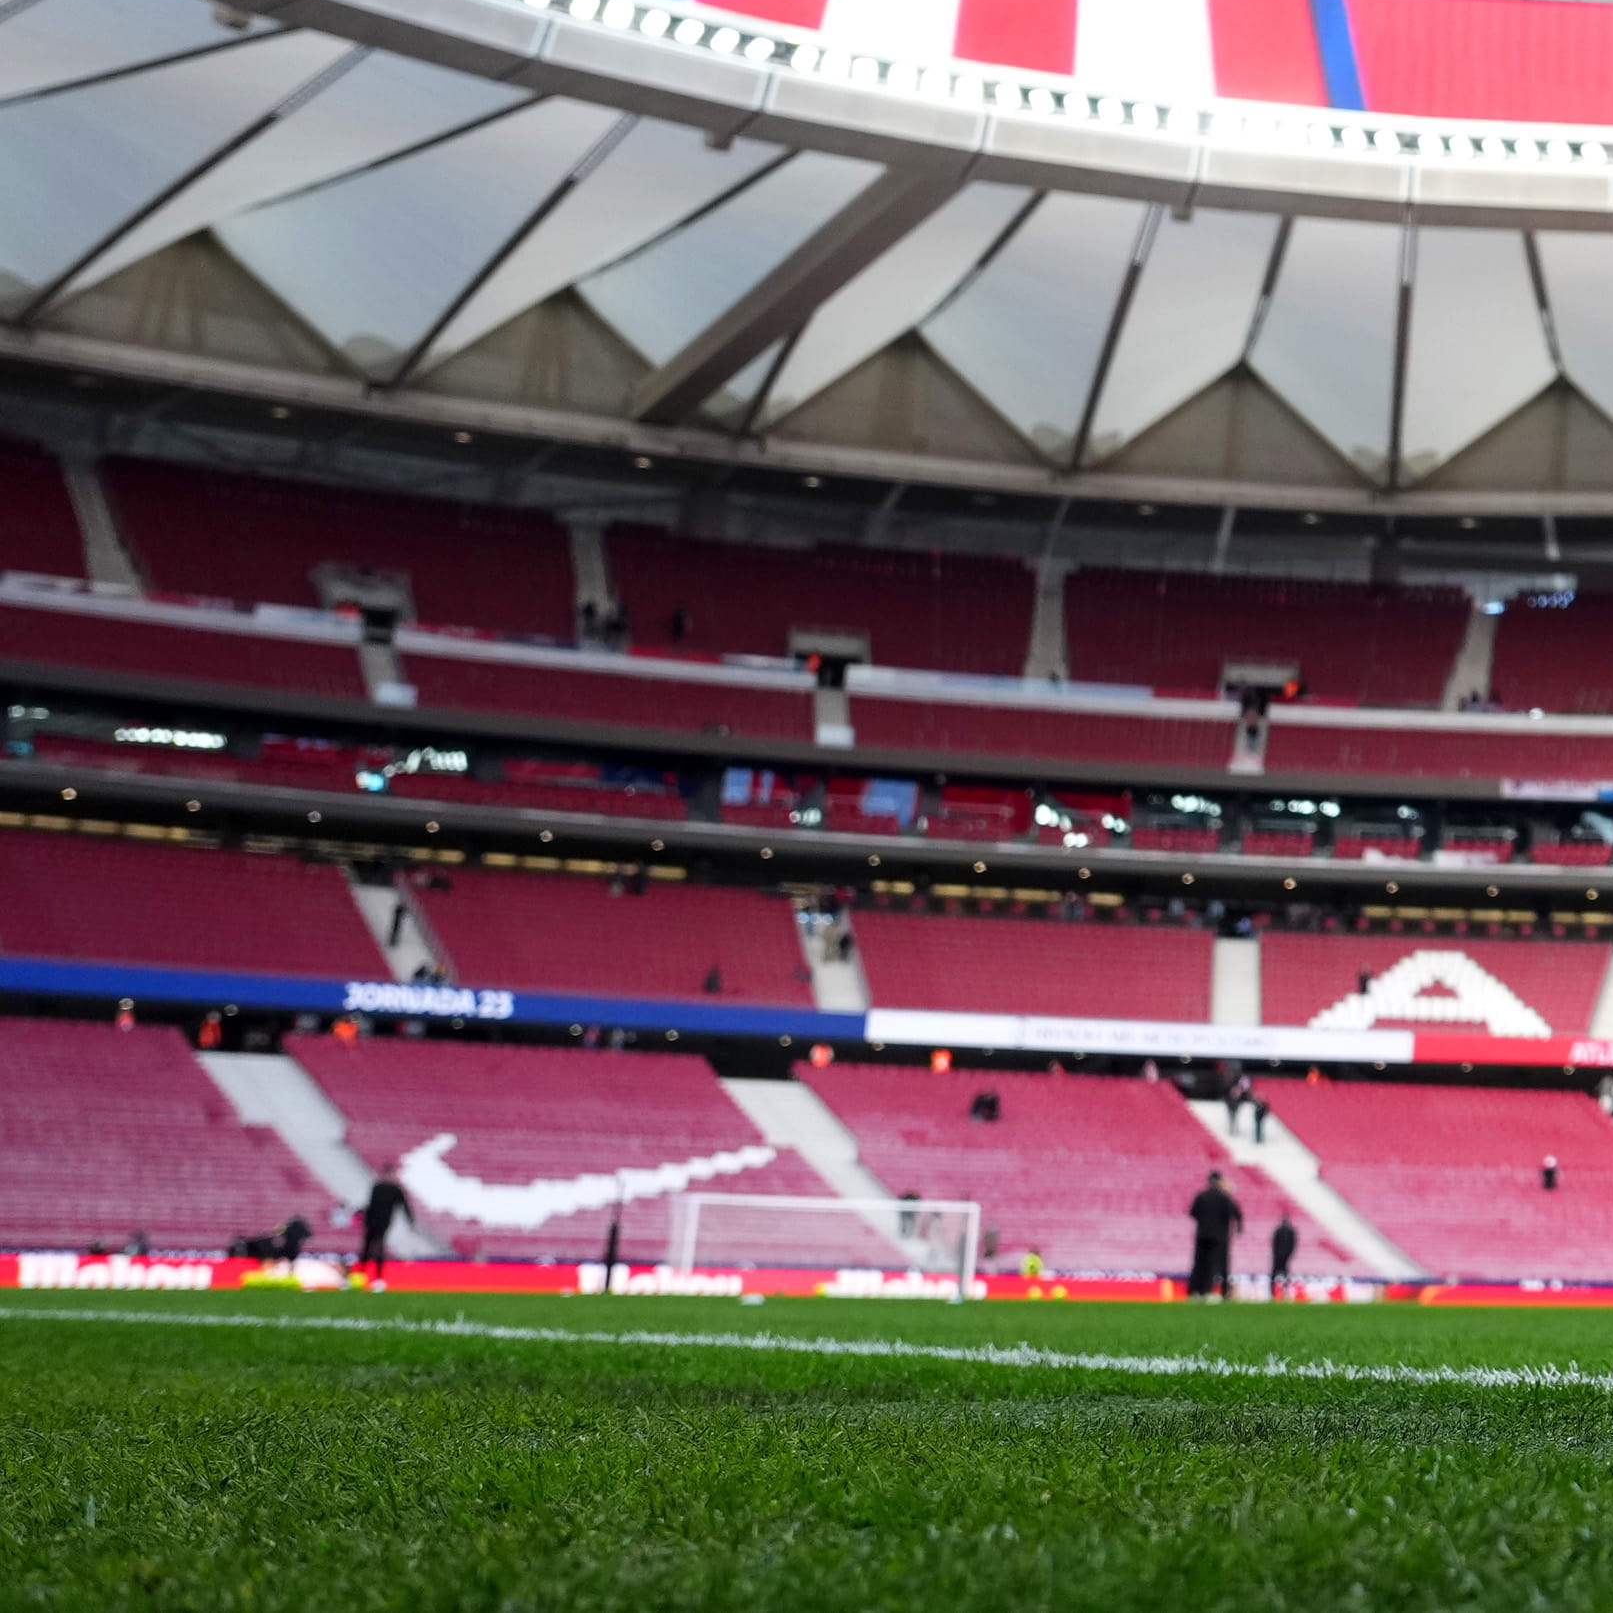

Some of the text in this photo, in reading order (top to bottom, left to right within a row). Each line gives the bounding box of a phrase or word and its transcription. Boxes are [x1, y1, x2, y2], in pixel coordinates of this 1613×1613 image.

[343, 982, 514, 1019] JORNADA 23
[18, 1253, 212, 1289] Mahou
